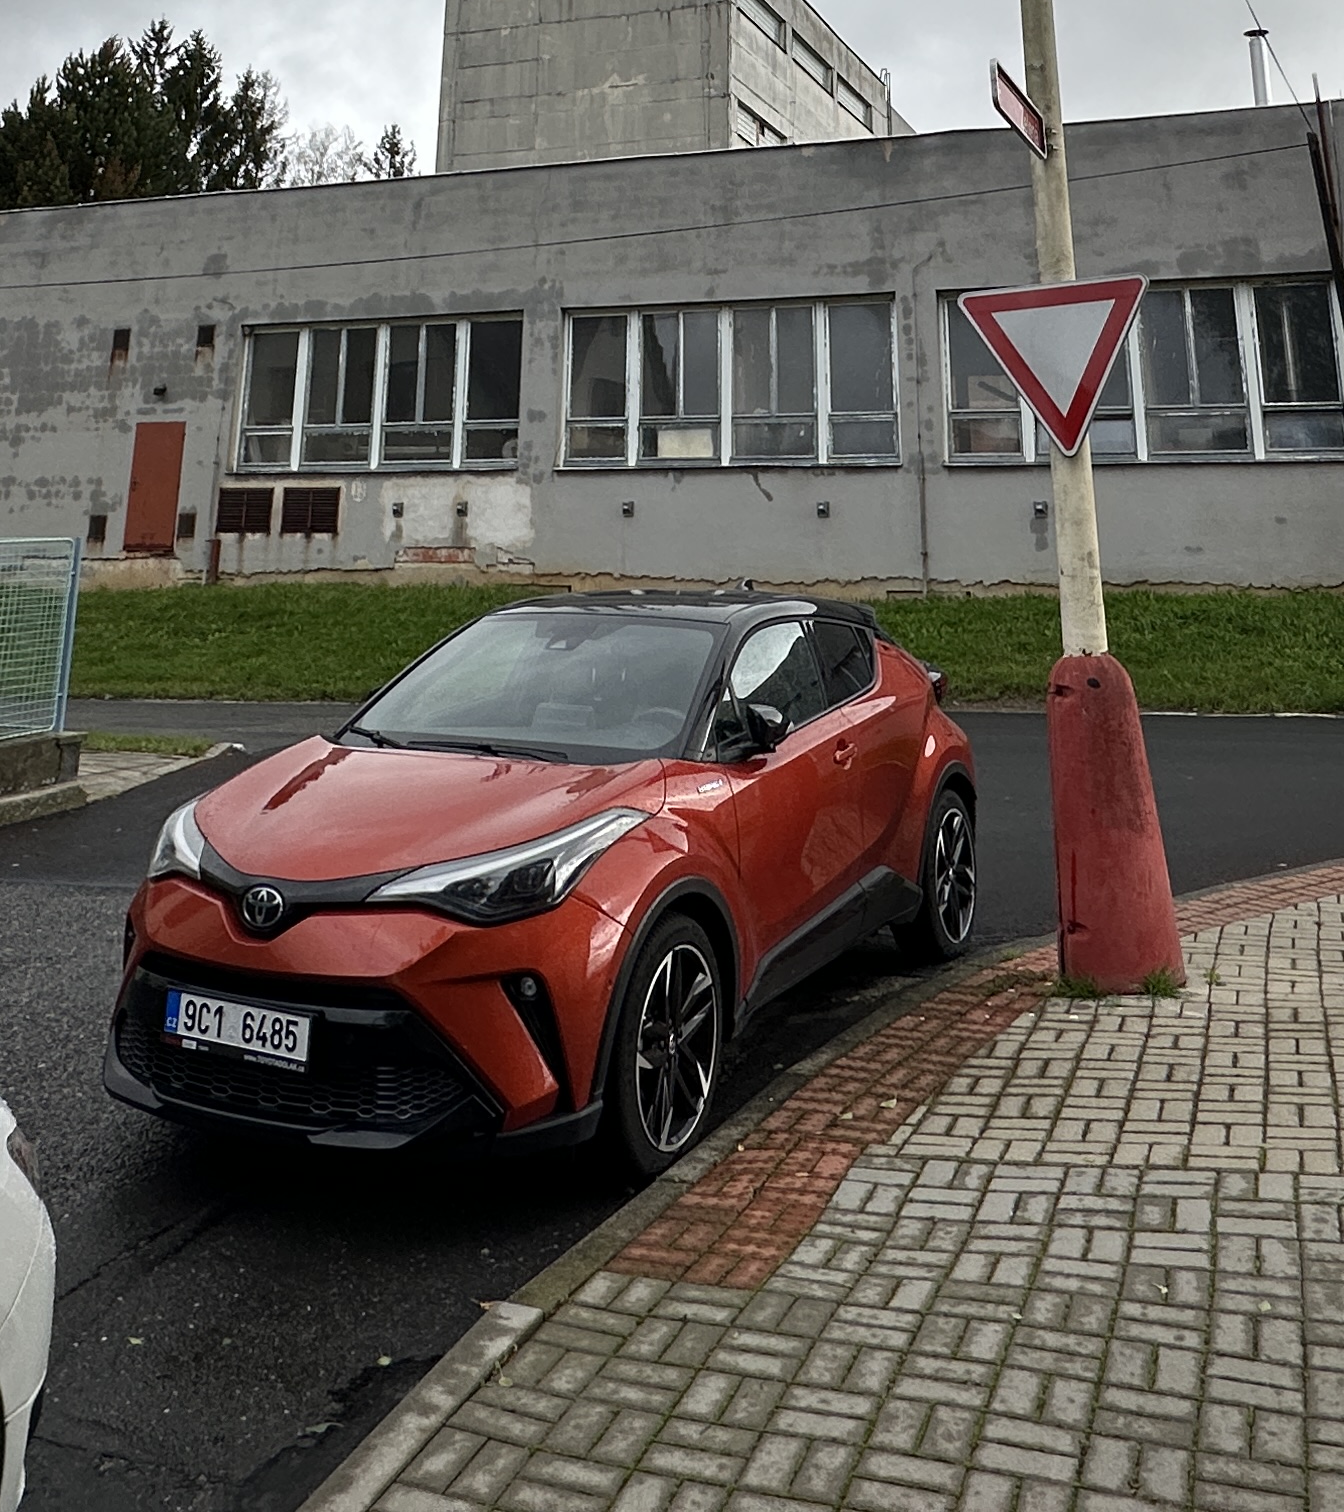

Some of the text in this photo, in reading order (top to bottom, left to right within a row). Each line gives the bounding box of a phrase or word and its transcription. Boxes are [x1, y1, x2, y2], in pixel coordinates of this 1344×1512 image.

[166, 1016, 178, 1029] CZ
[183, 999, 299, 1053] 9C1 6485
